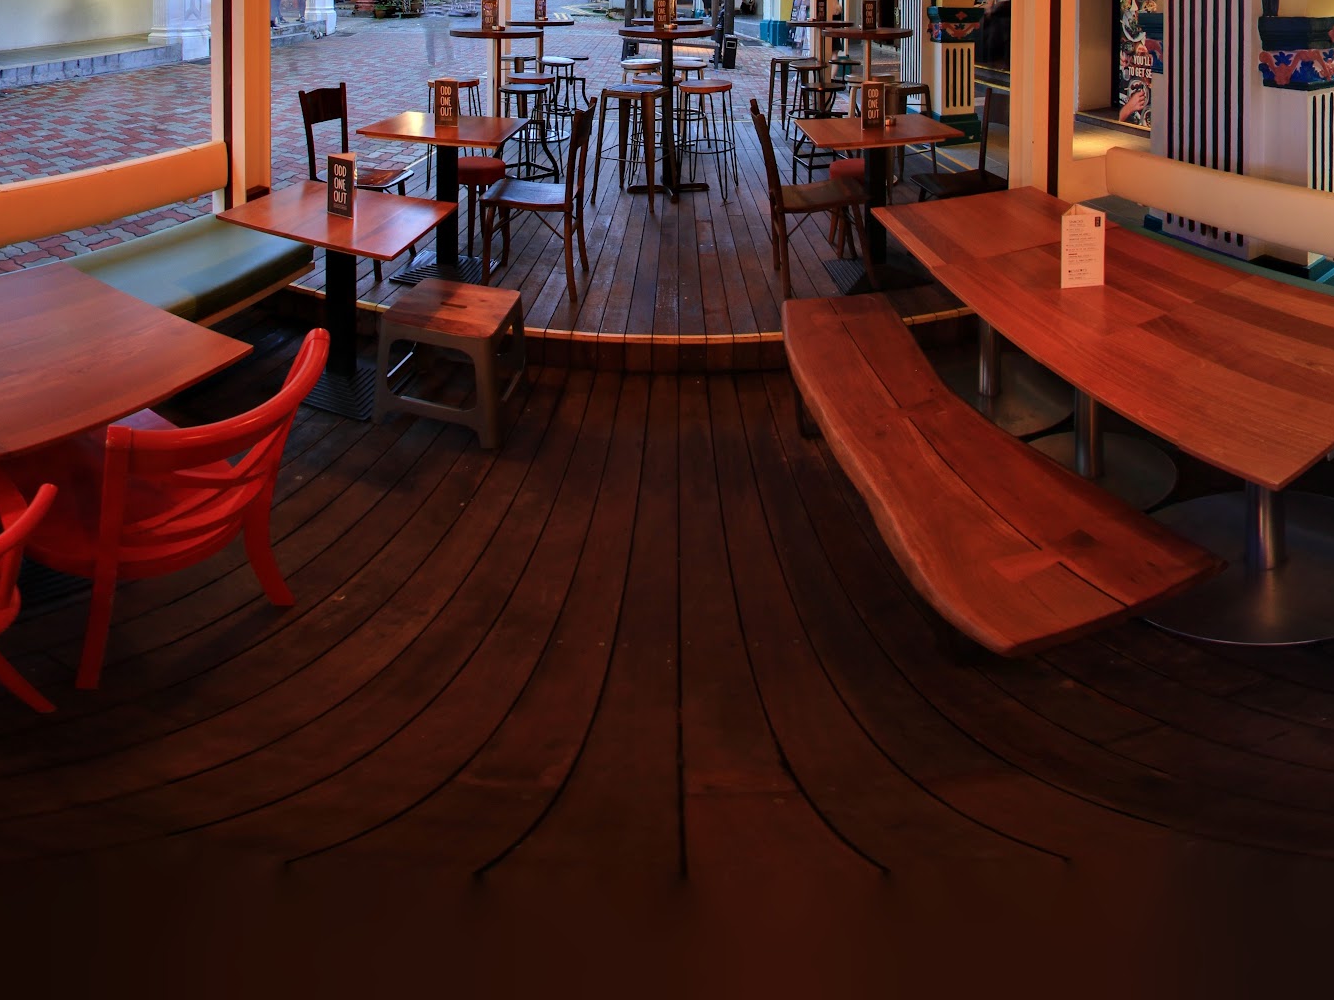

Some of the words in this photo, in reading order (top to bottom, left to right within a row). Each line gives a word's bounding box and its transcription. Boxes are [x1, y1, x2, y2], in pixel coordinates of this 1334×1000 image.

[1128, 66, 1134, 76] TO
[1135, 67, 1145, 78] GET
[1145, 68, 1153, 79] SE
[440, 85, 452, 96] ODD
[868, 89, 879, 98] ODD
[440, 96, 451, 107] ONE
[868, 99, 878, 108] ONE
[440, 106, 453, 117] OUT
[868, 109, 879, 119] OUT
[334, 164, 347, 177] ODD
[334, 178, 346, 191] ONE
[334, 191, 347, 204] OUT
